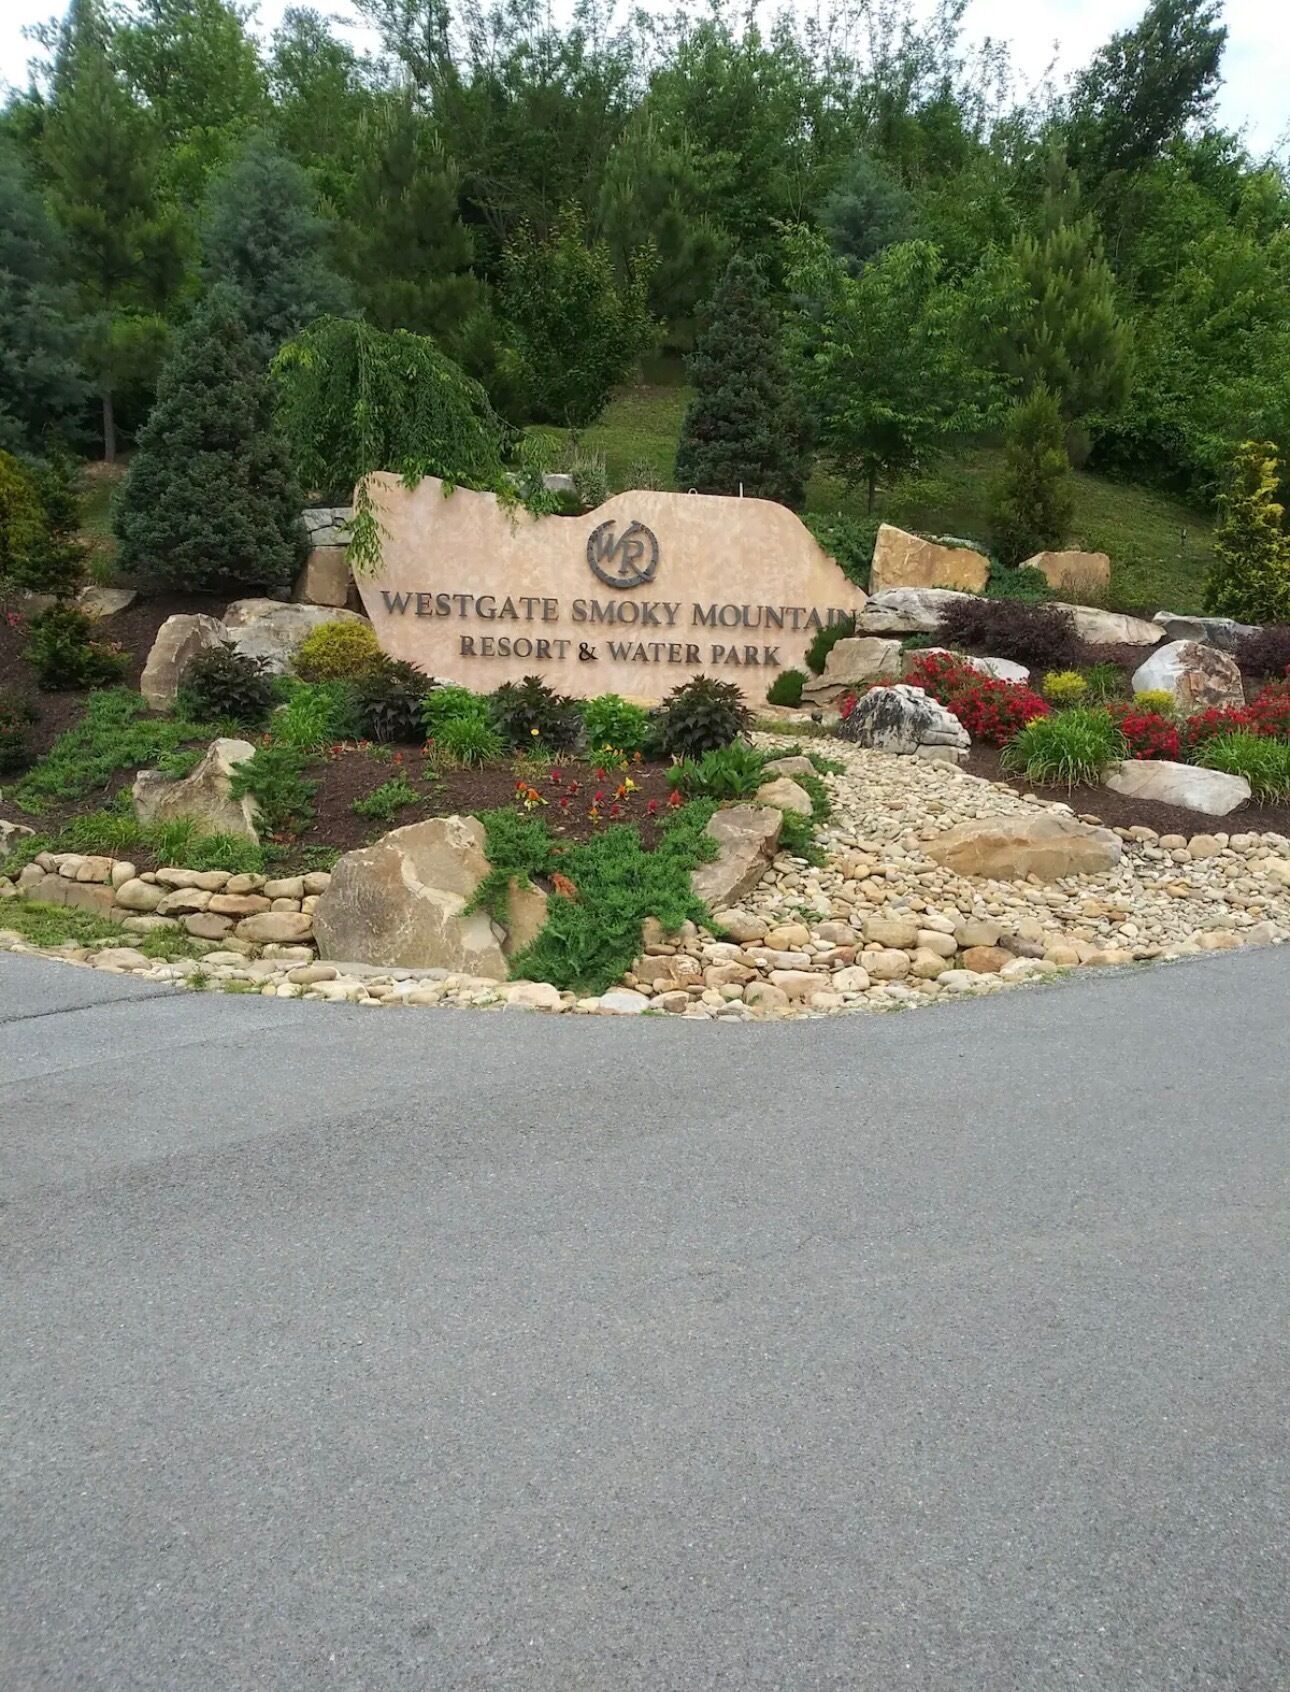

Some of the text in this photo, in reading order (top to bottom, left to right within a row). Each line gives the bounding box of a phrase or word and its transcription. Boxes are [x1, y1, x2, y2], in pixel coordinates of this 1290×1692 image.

[380, 591, 559, 621] WESTGATE
[571, 598, 682, 626] SMOKY
[459, 635, 781, 666] RESORT & WATER PARK
